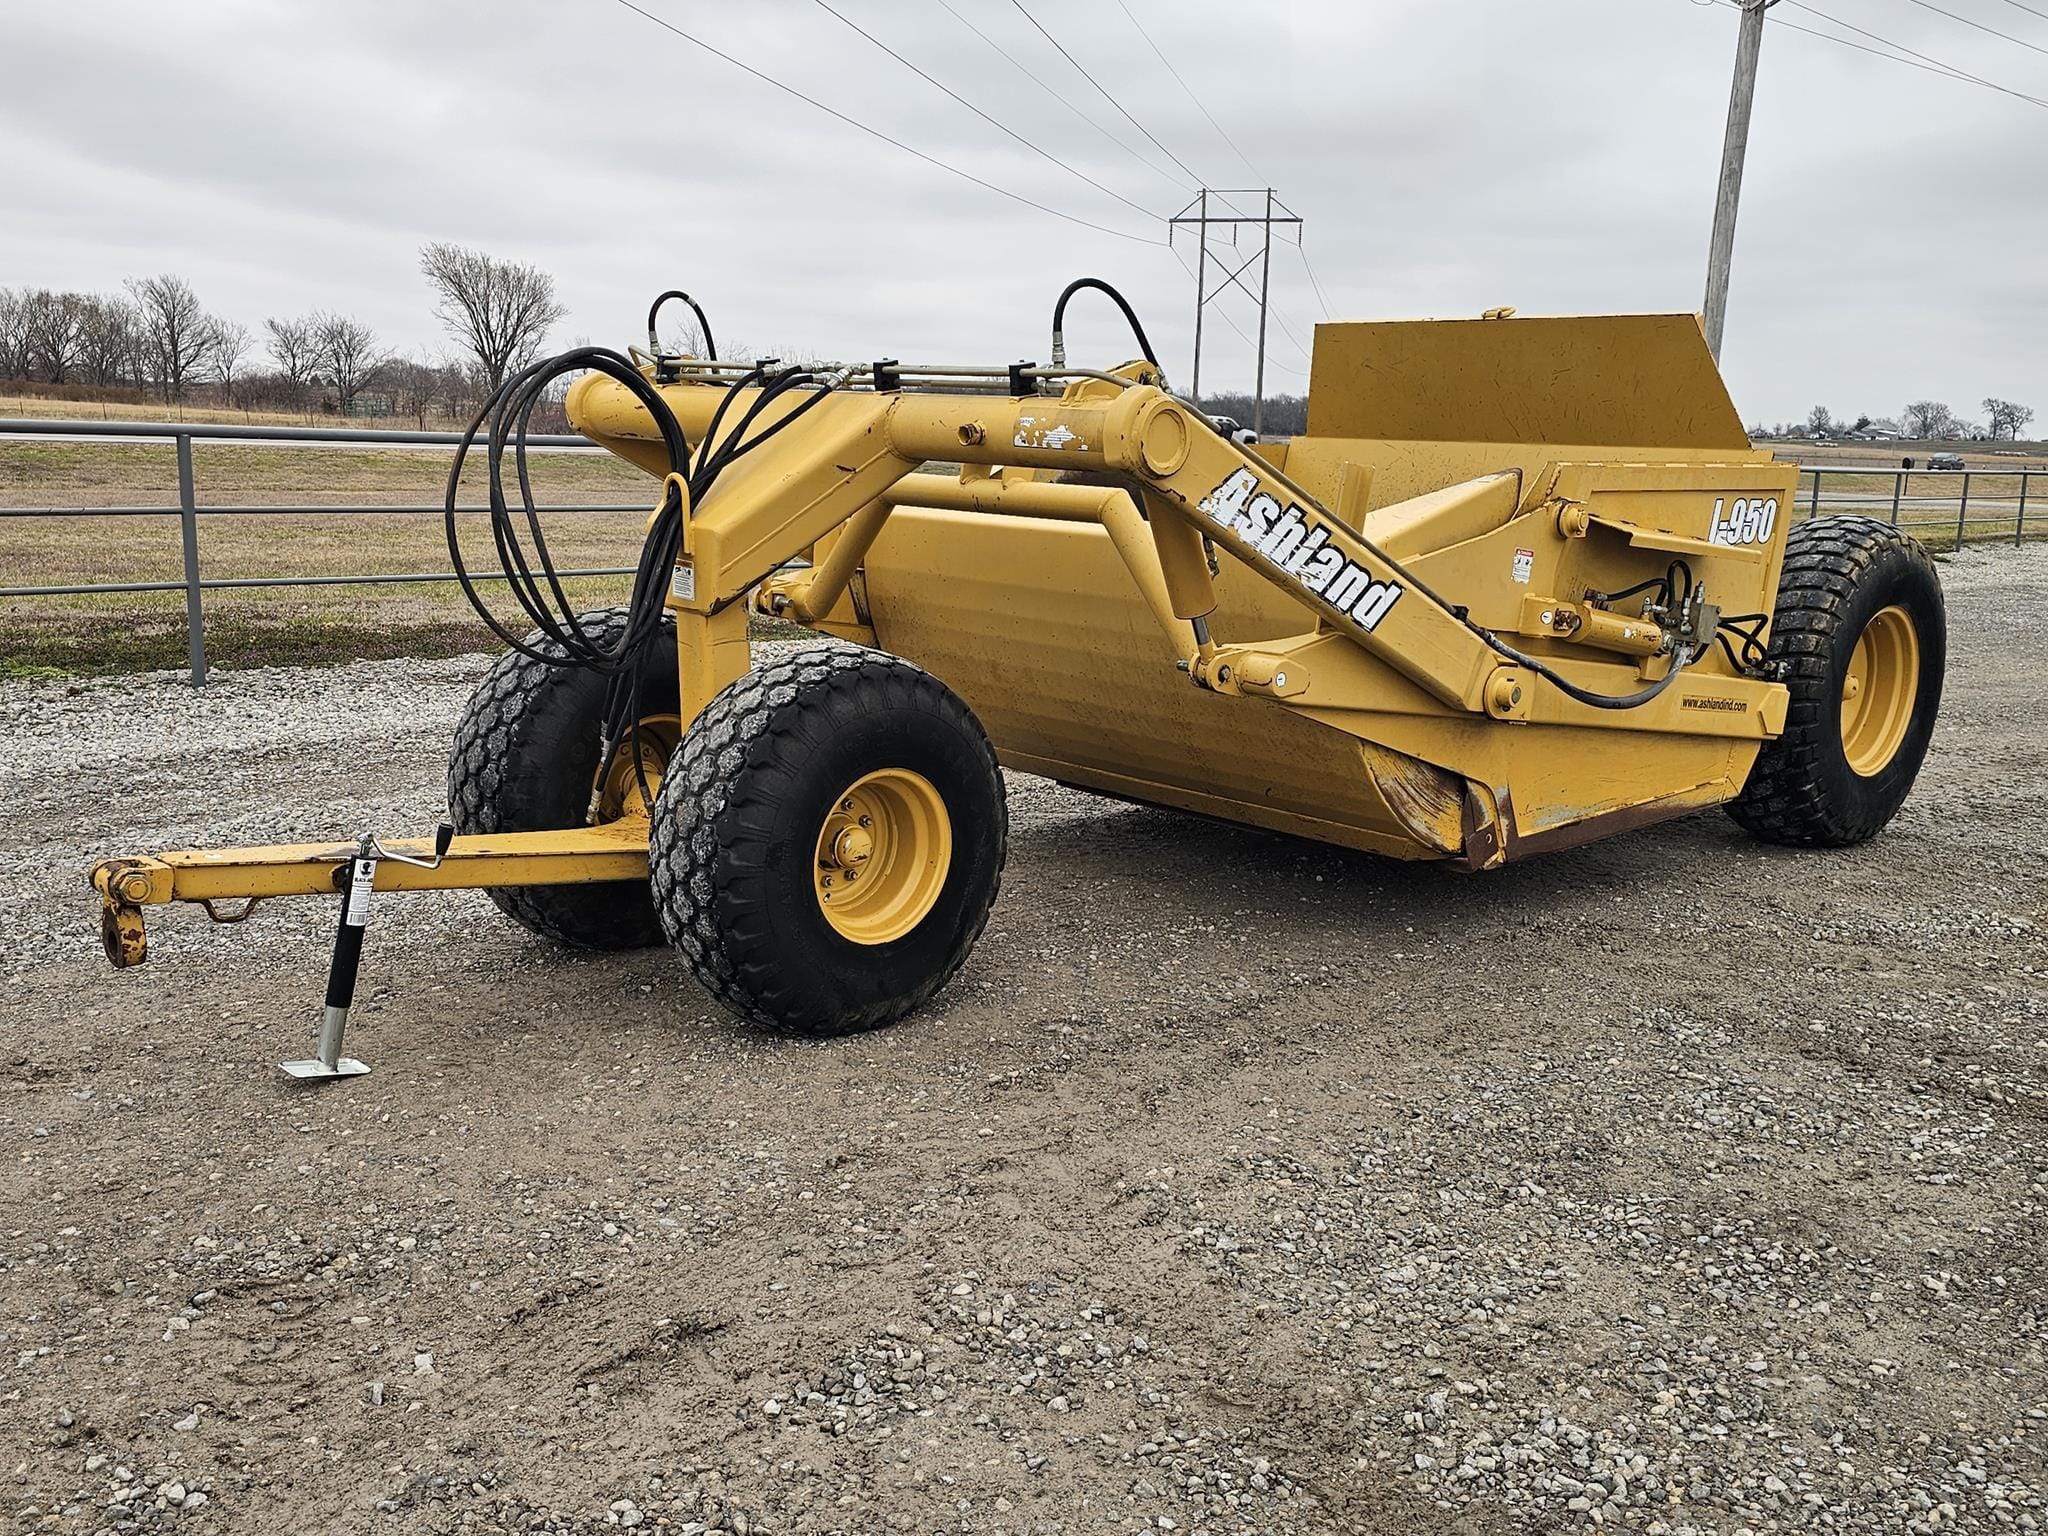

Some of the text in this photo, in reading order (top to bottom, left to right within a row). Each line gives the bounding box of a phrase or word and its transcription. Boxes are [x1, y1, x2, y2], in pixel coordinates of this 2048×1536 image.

[1708, 498, 1777, 544] I-950
[1197, 465, 1405, 632] Ashland
[1682, 697, 1747, 712] www.ashlandind.com
